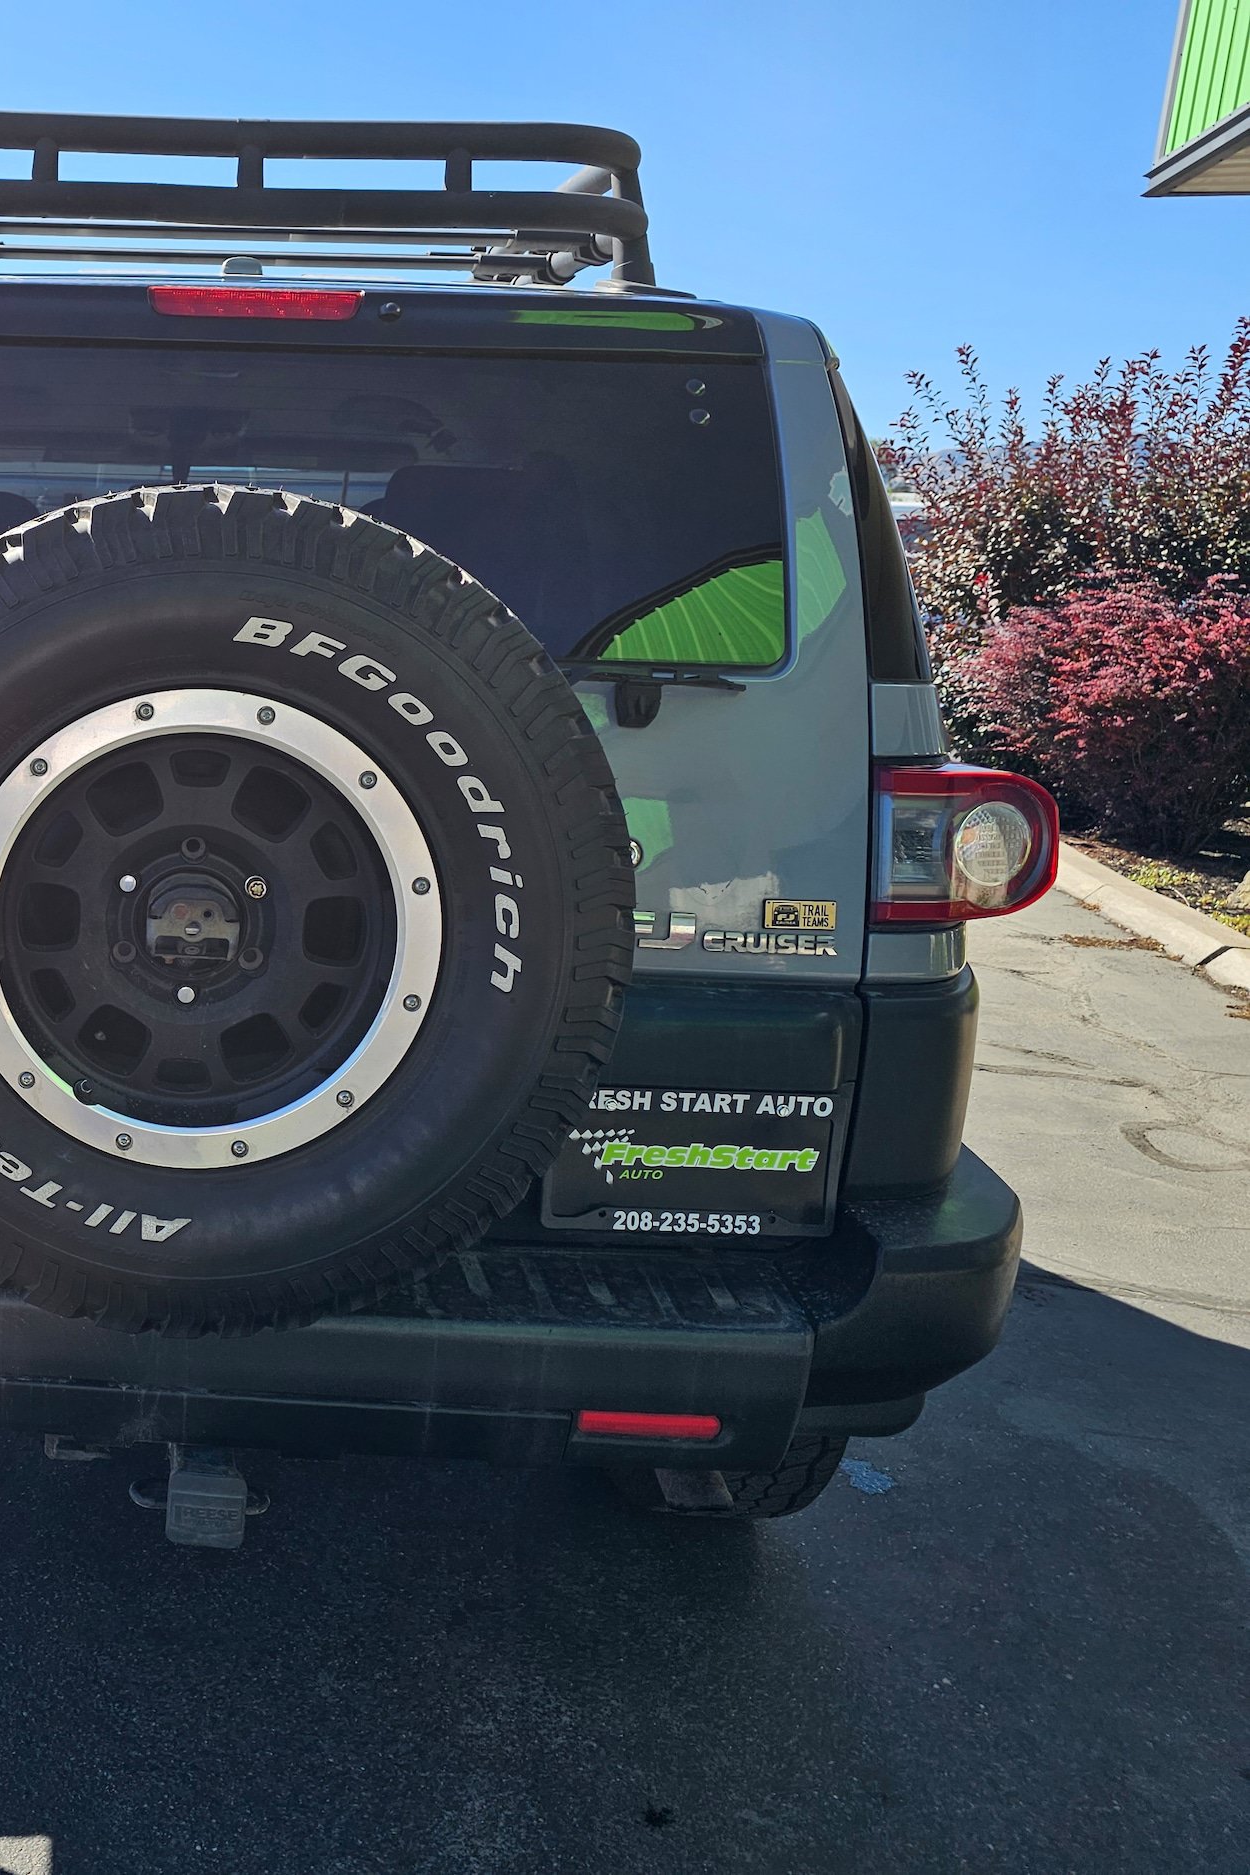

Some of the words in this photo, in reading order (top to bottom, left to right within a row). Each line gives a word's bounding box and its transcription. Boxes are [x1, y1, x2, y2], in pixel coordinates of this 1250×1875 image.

[233, 616, 524, 993] BFGoodrich
[802, 904, 829, 917] TRAIL
[802, 916, 829, 927] TEAMS
[703, 930, 838, 956] CRUISER
[588, 1090, 652, 1111] ESH
[660, 1092, 751, 1114] START
[755, 1094, 834, 1117] AUTO
[600, 1142, 820, 1173] FreshStart
[618, 1169, 664, 1181] AUTO
[612, 1210, 762, 1236] 208-235-5353
